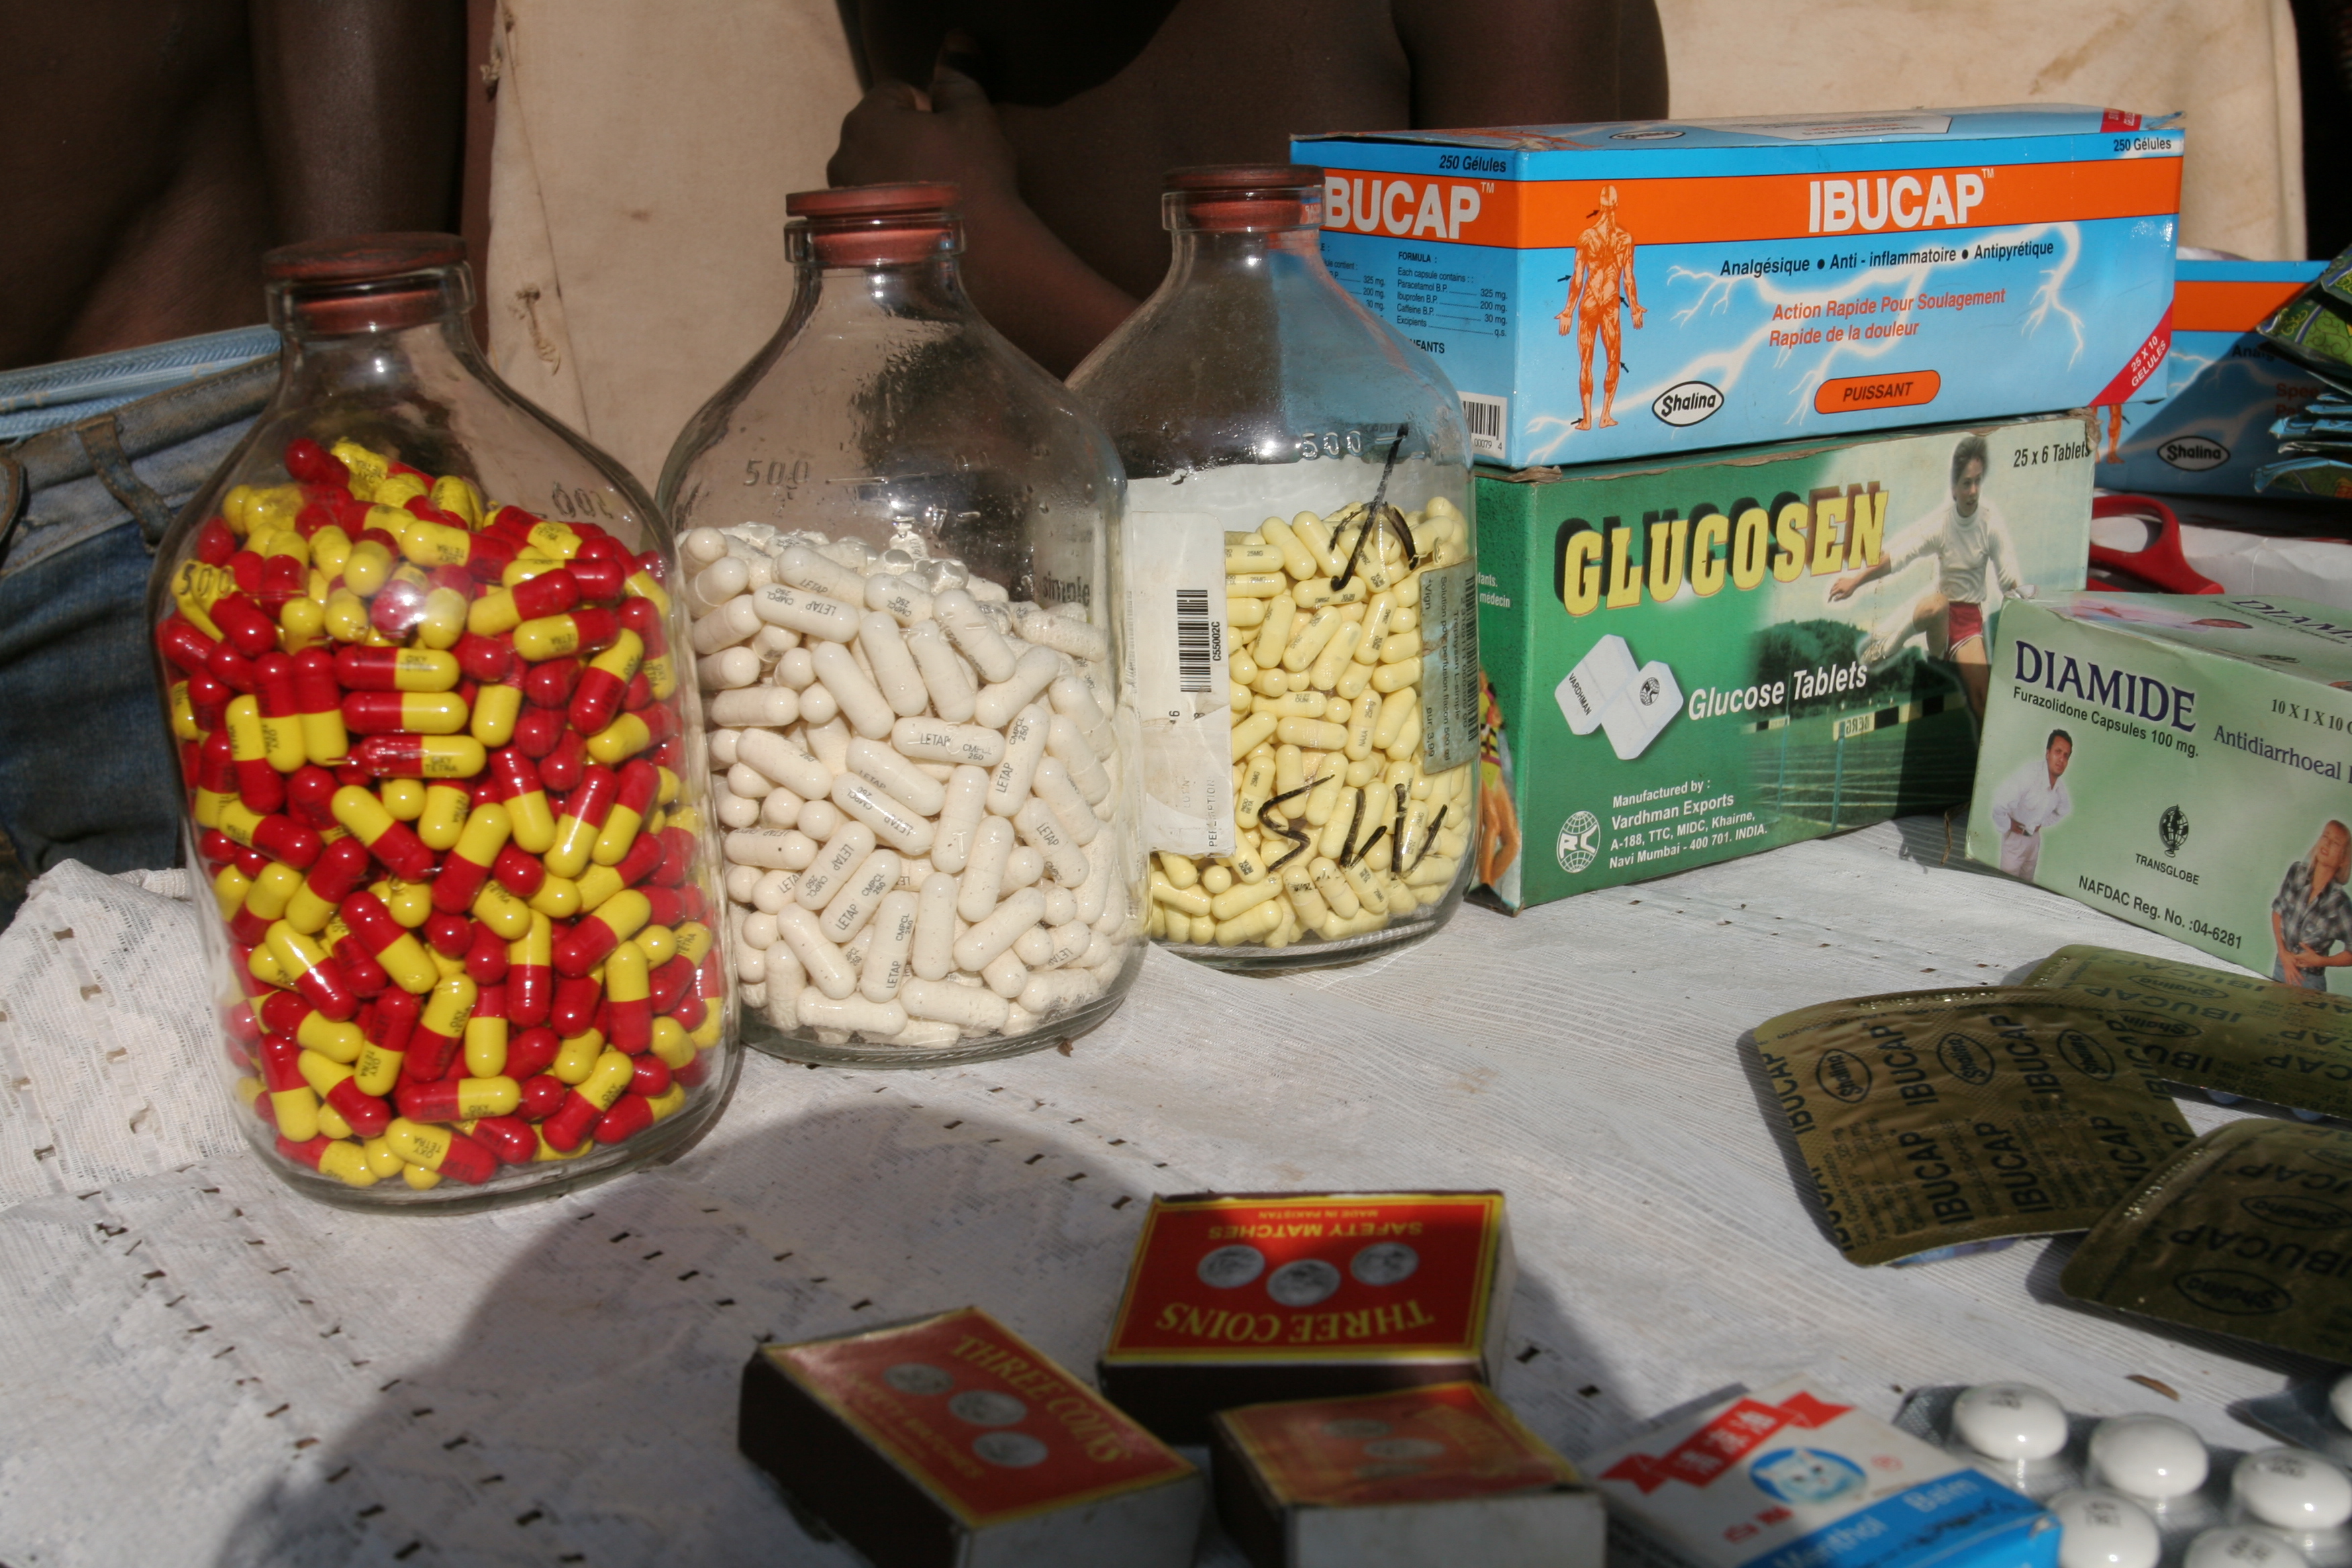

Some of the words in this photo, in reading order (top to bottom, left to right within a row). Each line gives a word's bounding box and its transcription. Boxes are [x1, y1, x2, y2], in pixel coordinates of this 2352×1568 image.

[2114, 139, 2130, 151] 250
[2134, 138, 2171, 150] Gélules
[1438, 154, 1459, 169] 250
[1463, 155, 1506, 173] Gélules
[1324, 176, 1481, 240] BUCAP
[1809, 173, 1984, 234] IBUCAP
[1398, 251, 1431, 263] FORMULA
[1720, 255, 1810, 277] Analgésique
[1830, 252, 1858, 269] Anti
[1869, 246, 1957, 266] inflammatoire
[1974, 240, 2054, 260] Antipyrétique
[1398, 267, 1413, 277] Each
[1414, 270, 1438, 280] capsule
[1439, 272, 1466, 283] contains
[1398, 279, 1434, 291] Paracetamol
[1480, 289, 1493, 297] 325
[1397, 291, 1425, 303] Ibuprofen
[1480, 301, 1493, 310] 200
[1397, 303, 1422, 315] Caffeine
[1484, 313, 1493, 323] 30
[1772, 302, 1822, 322] Action
[1827, 297, 1877, 319] Rapide
[1881, 294, 1914, 313] Pour
[1917, 287, 2006, 312] Soulagement
[1397, 315, 1427, 328] Excipients
[1769, 328, 1820, 348] Rapide
[1824, 326, 1845, 343] de
[1847, 324, 1861, 341] la
[1864, 320, 1920, 340] douleur
[2130, 359, 2142, 373] 25
[2141, 348, 2149, 358] X
[2148, 336, 2159, 348] 10
[2130, 340, 2167, 387] GELULES
[1660, 391, 1717, 418] Shalina
[1842, 381, 1913, 403] PUISSANT
[2014, 449, 2028, 467] 25
[2030, 452, 2039, 465] x
[2041, 446, 2049, 464] 6
[2052, 440, 2090, 462] Tablets
[2167, 444, 2222, 462] Shalina
[743, 459, 810, 487] 500
[1561, 487, 1890, 617] GLUCOSEN
[805, 600, 837, 616] LETAP
[1479, 592, 1510, 608] médecin
[1212, 621, 1222, 661] C55002C
[1568, 673, 1592, 716] VARDHMAN
[1688, 680, 1785, 721] Glucose
[1793, 660, 1868, 701] Tablets
[2015, 640, 2197, 733] DIAMIDE
[2013, 686, 2088, 722] Furazolidone
[2091, 711, 2147, 740] Capsules
[2151, 729, 2173, 748] 100
[2271, 699, 2286, 714] 10
[2289, 703, 2300, 720] X
[2313, 710, 2325, 726] X
[2329, 715, 2343, 731] 10
[1009, 716, 1025, 745] CMPCL
[1018, 725, 1030, 742] 250
[1358, 730, 1369, 748] NAXA
[2213, 725, 2341, 780] Antidiarrhoeal
[425, 764, 458, 773] TETRA
[995, 762, 1014, 793] LETAP
[1613, 781, 1687, 809] Manufactured
[1690, 780, 1704, 797] by
[1612, 805, 1679, 830] Vardhman
[1683, 793, 1734, 816] Exports
[1036, 822, 1059, 846] LETAP
[1610, 832, 1645, 852] A-188,
[1649, 826, 1673, 842] TTC,
[1677, 820, 1708, 838] MIDC,
[1711, 811, 1755, 830] Khairne,
[832, 843, 855, 871] LETAP
[1610, 854, 1634, 869] Navi
[1636, 842, 1680, 862] Mumbai
[1689, 836, 1708, 851] 400
[1735, 824, 1768, 841] INDIA.
[805, 875, 818, 889] 250
[2135, 852, 2200, 885] TRANSGLOBE
[805, 875, 828, 898] CMPCL
[861, 873, 885, 897] CMPCL
[873, 881, 886, 895] 250
[2078, 875, 2130, 907] NAFDAC
[2133, 895, 2160, 920] Reg.
[2164, 906, 2186, 929] No.
[835, 903, 859, 931] LETAP
[895, 913, 910, 941] CMPCL
[885, 961, 901, 989] LETAP
[2084, 986, 2242, 1023] IBUCAP
[450, 1010, 465, 1028] OXY
[360, 1050, 376, 1077] TETRA
[369, 1057, 381, 1077] OXY
[1870, 1023, 1940, 1106] IBUCAP
[1990, 1014, 2065, 1095] IBUCAP
[414, 1136, 442, 1154] TETRA
[1898, 1130, 1974, 1224] IBUCAP
[1973, 1122, 2054, 1214] IBUCAP
[1209, 1223, 1323, 1240] MATCHES
[1329, 1222, 1422, 1238] SAFETY
[1157, 1302, 1281, 1342] COINS
[1289, 1300, 1435, 1343] THREE
[950, 1333, 1057, 1408] THREE
